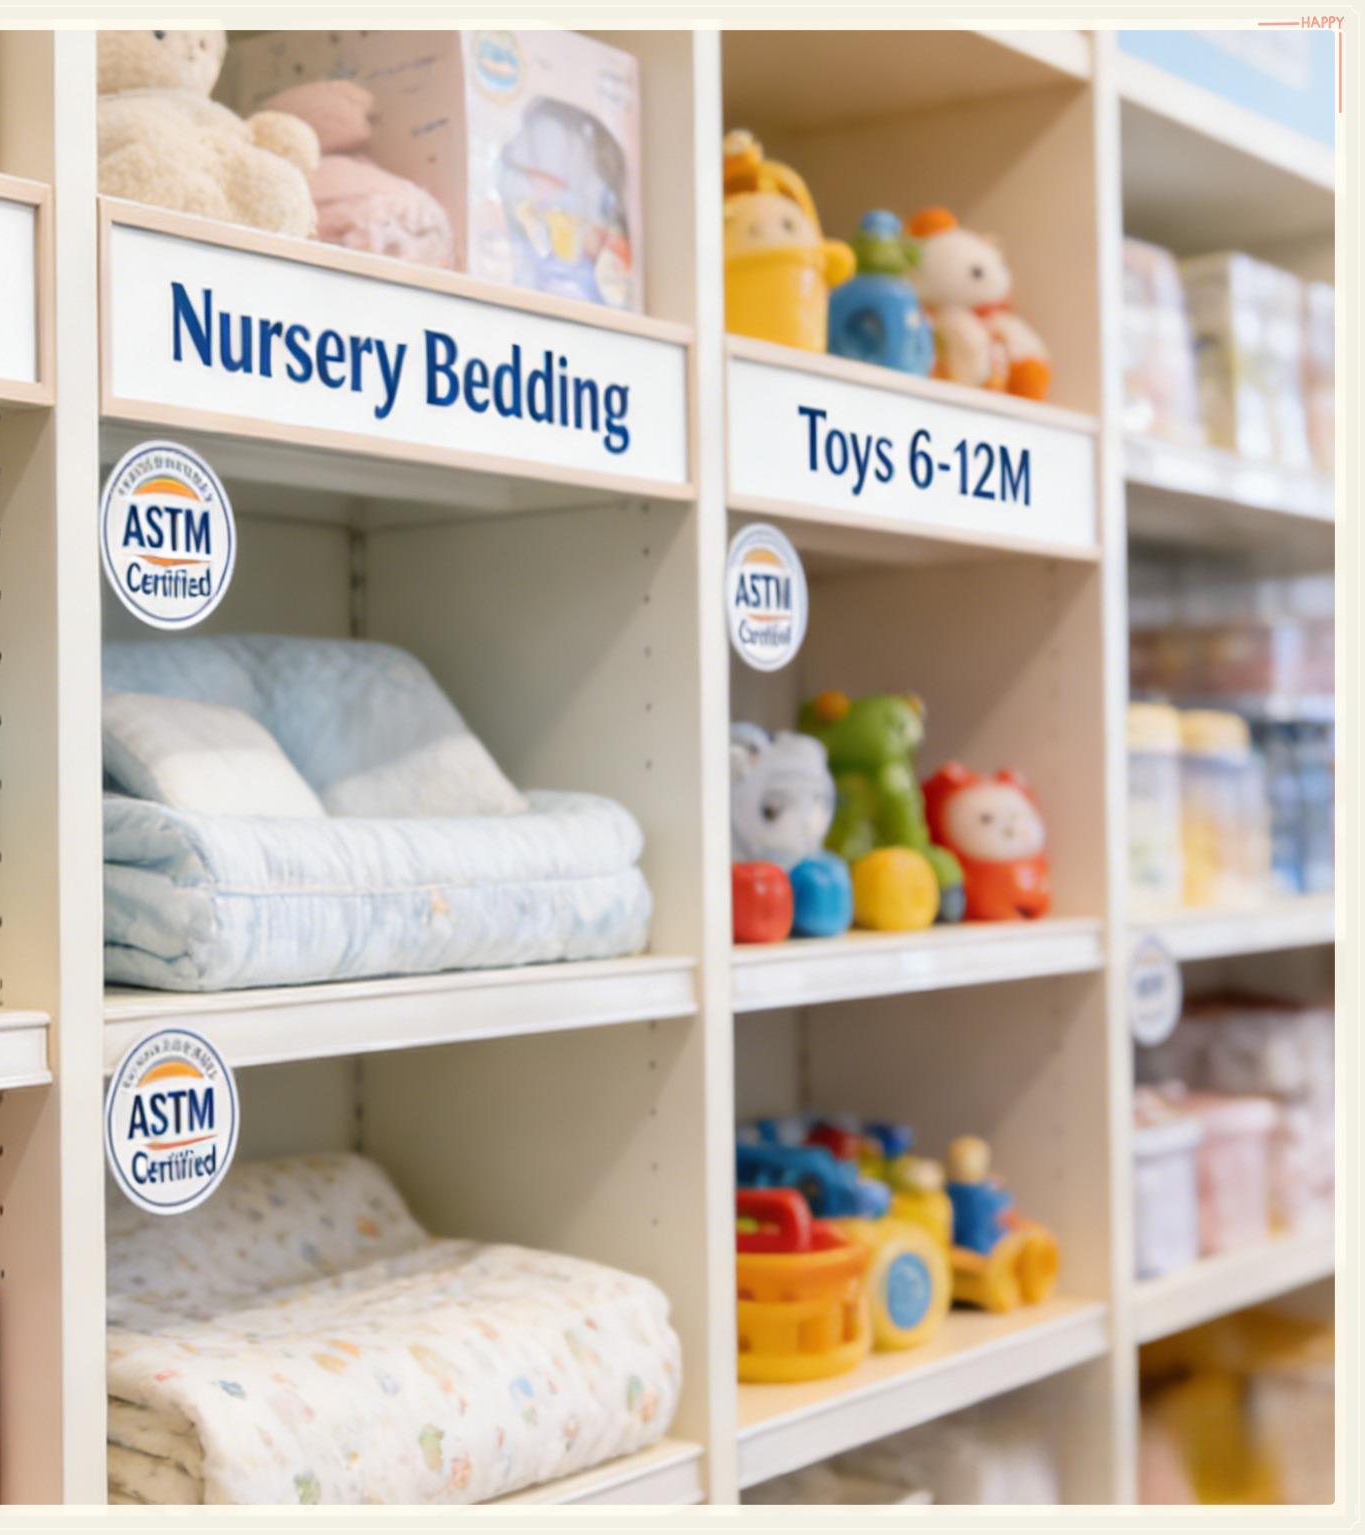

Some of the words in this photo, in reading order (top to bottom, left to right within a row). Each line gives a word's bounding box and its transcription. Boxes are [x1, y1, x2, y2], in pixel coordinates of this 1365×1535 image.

[171, 282, 407, 419] Nursery
[424, 330, 630, 455] Bedding
[798, 406, 894, 496] Toys
[909, 429, 1030, 506] 6-12M
[123, 504, 211, 555] ASTM
[126, 562, 212, 598] Certified
[128, 1087, 214, 1140] ASTM
